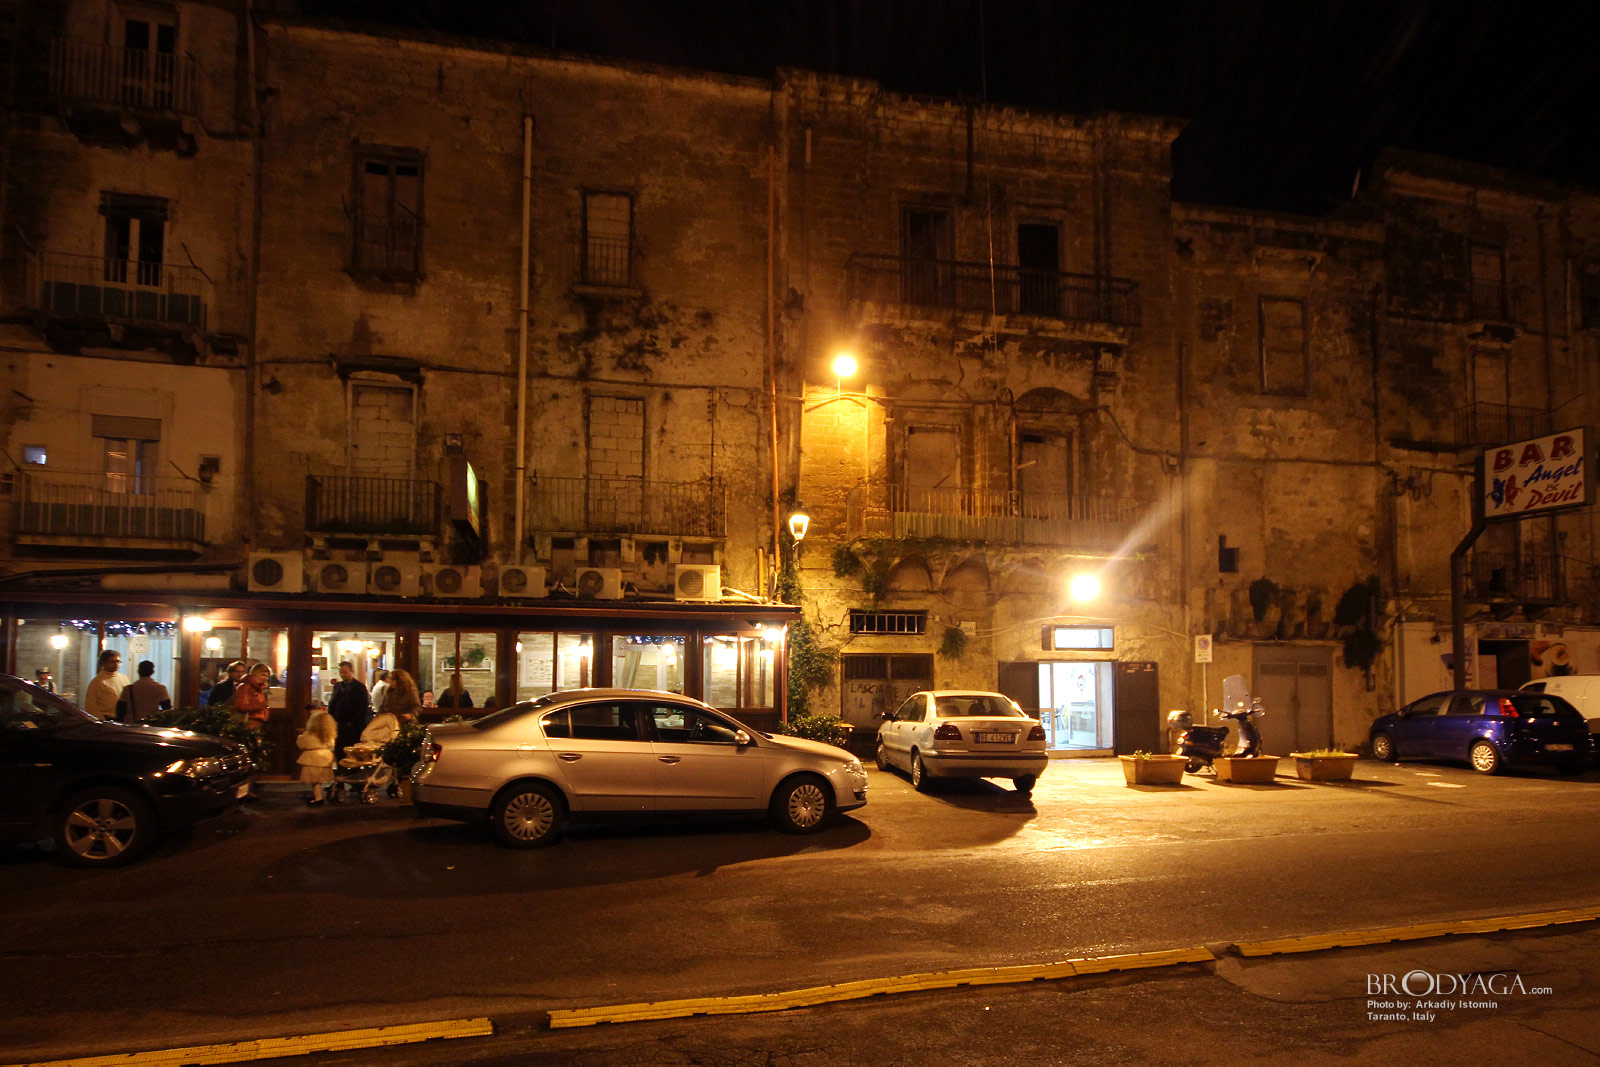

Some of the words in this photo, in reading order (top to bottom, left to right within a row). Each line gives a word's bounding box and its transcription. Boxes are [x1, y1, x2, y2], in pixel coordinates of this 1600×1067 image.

[1493, 435, 1575, 473] BAR
[1523, 456, 1583, 488] Angel
[1525, 481, 1582, 509] Devil
